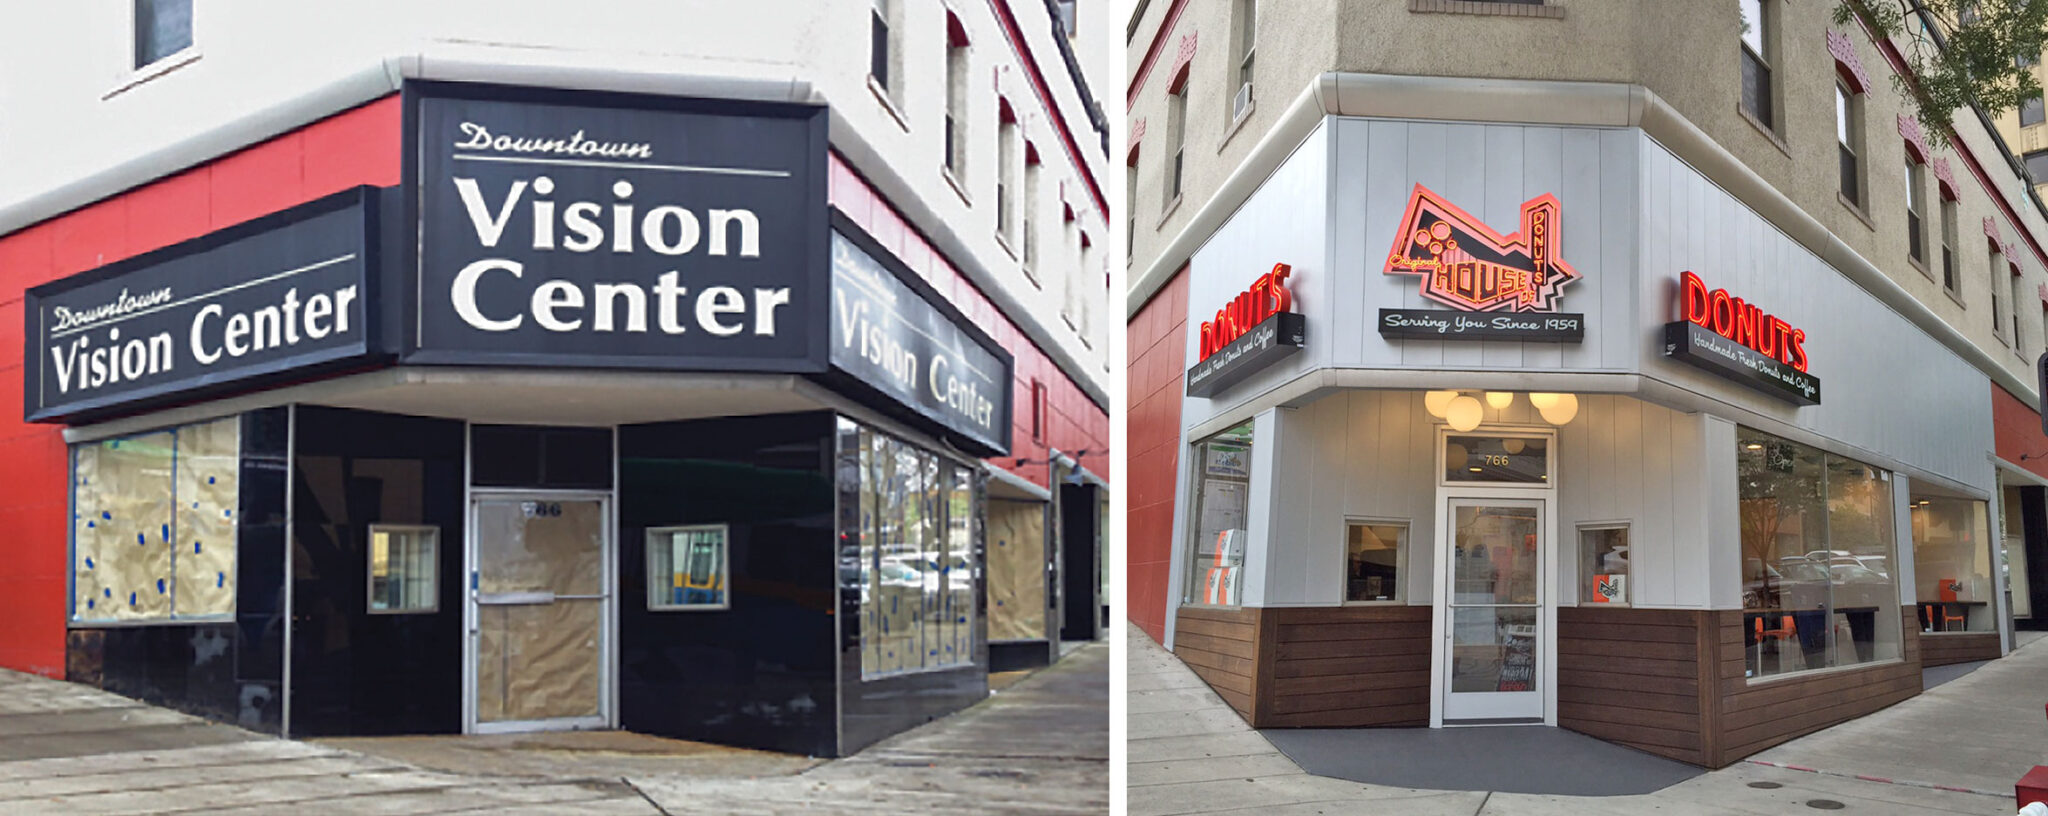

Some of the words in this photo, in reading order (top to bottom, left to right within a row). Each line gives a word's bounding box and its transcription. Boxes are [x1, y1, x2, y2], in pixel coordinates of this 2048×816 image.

[454, 120, 654, 160] Downtown
[452, 175, 761, 258] Vision
[1531, 211, 1545, 284] DONUTS
[1389, 253, 1442, 271] Original
[1435, 260, 1527, 304] HOUSE
[51, 286, 172, 332] Downtown
[450, 257, 791, 337] Center
[1199, 262, 1292, 363] DONUTS
[1384, 313, 1450, 334] Serving
[1454, 316, 1487, 333] You
[1491, 317, 1541, 331] Since
[1544, 319, 1578, 331] 1959
[1680, 270, 1809, 373] DONUTS
[51, 327, 173, 394] Vision
[189, 283, 358, 365] Center
[837, 287, 917, 390] Vision
[929, 353, 993, 430] Center
[1694, 332, 1737, 361] Handmade
[1737, 350, 1758, 370] Fresh
[1758, 360, 1780, 379] Donuts
[1782, 372, 1795, 386] and
[1795, 376, 1816, 398] Coffee
[1485, 455, 1509, 466] 766
